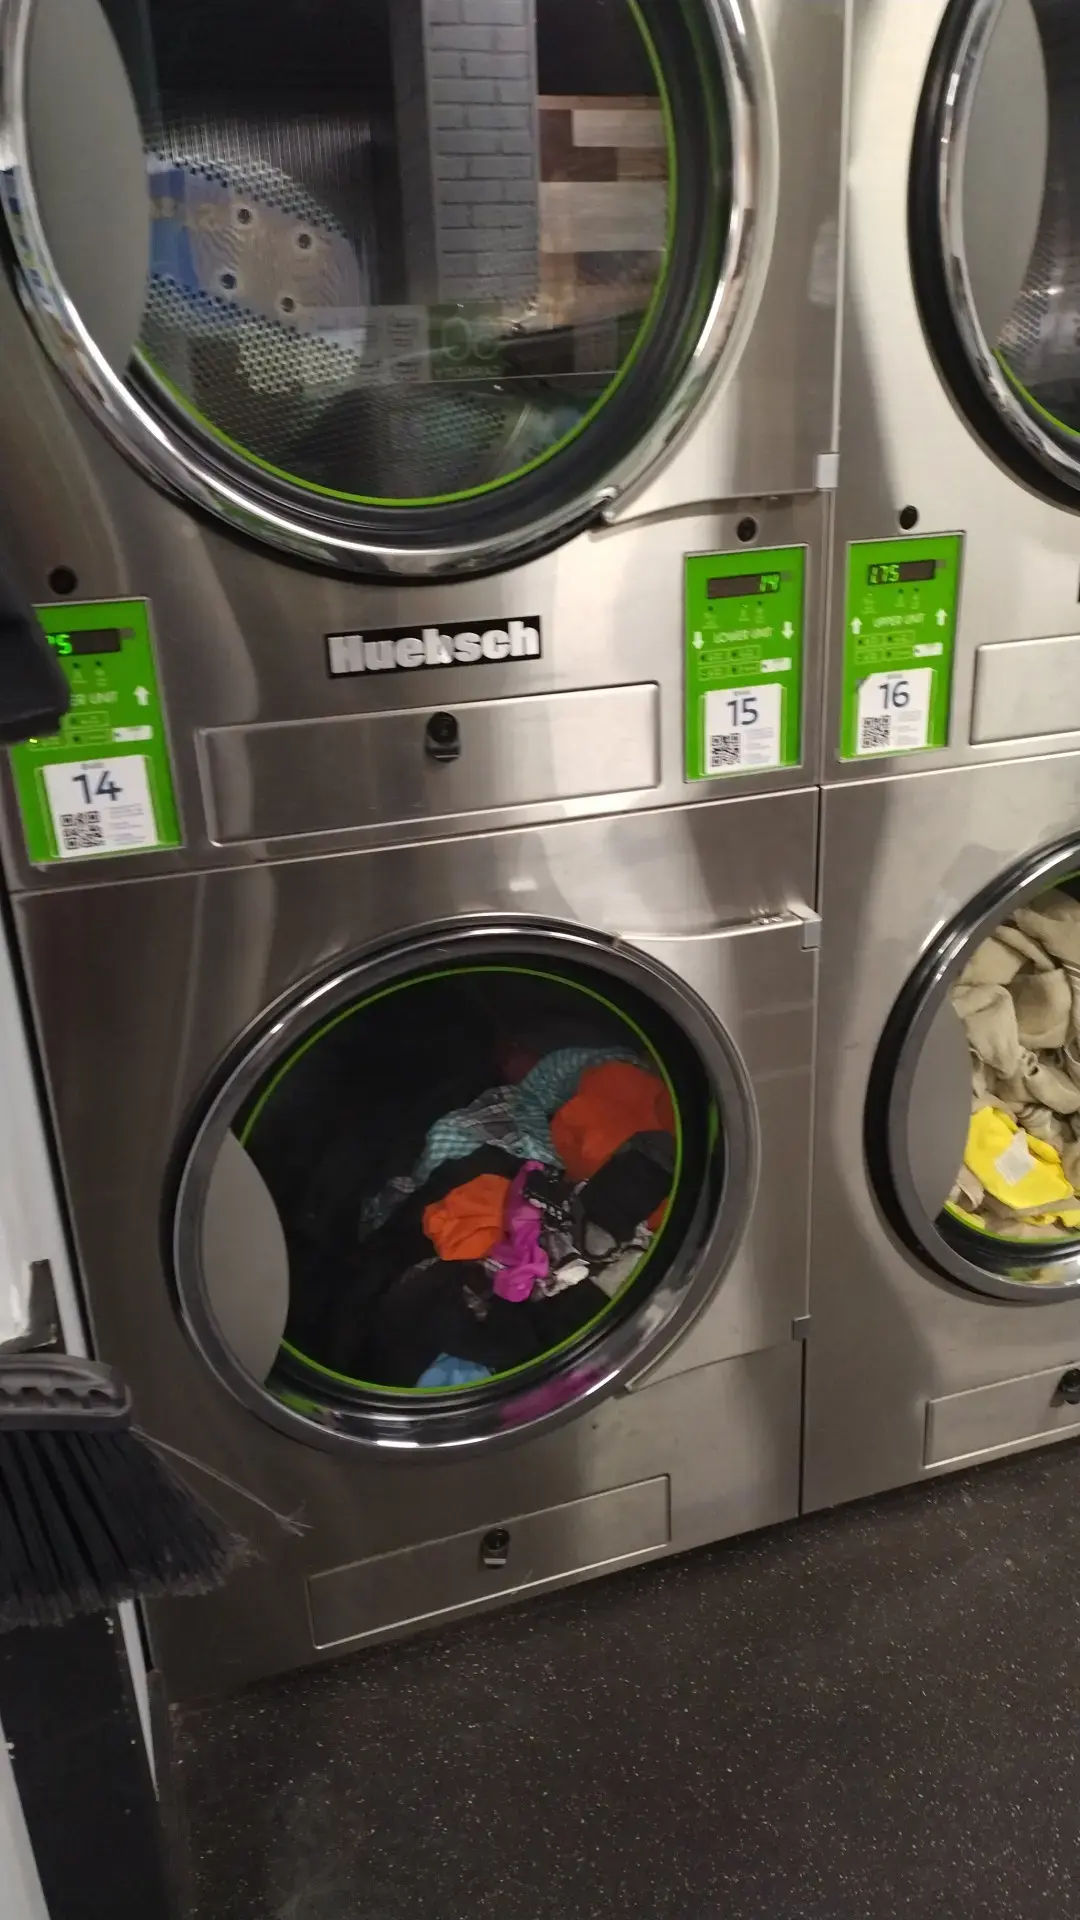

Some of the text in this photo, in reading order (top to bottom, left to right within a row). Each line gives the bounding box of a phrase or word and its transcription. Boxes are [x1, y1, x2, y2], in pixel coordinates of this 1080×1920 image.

[328, 621, 539, 674] Huebsch
[879, 680, 910, 709] 16
[726, 697, 760, 727] 15
[72, 771, 124, 805] 14
